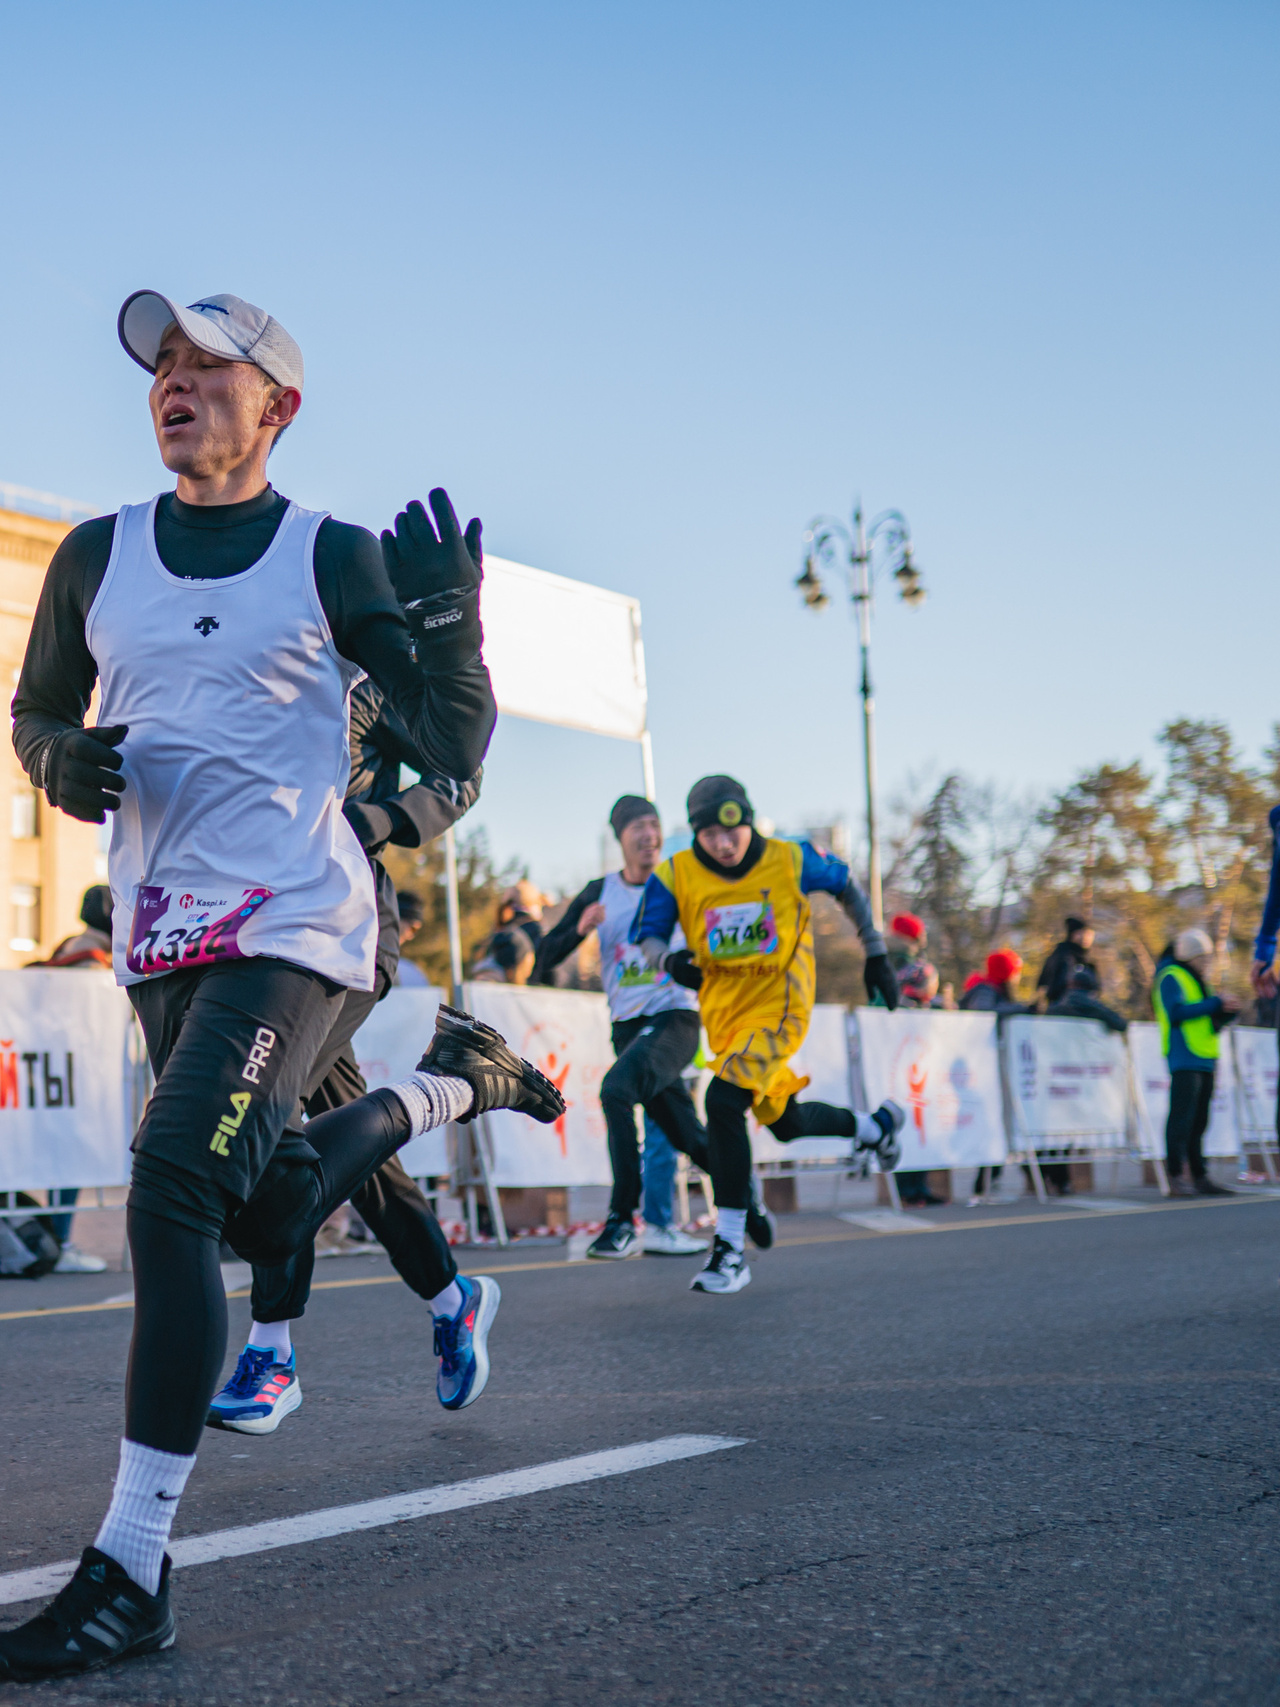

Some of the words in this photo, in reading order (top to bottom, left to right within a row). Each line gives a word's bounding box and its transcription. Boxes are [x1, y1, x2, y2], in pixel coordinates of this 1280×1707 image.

[196, 899, 227, 908] Kaspi.kz
[716, 922, 770, 947] 1746
[209, 1091, 252, 1157] FILA
[241, 1026, 276, 1085] PRO
